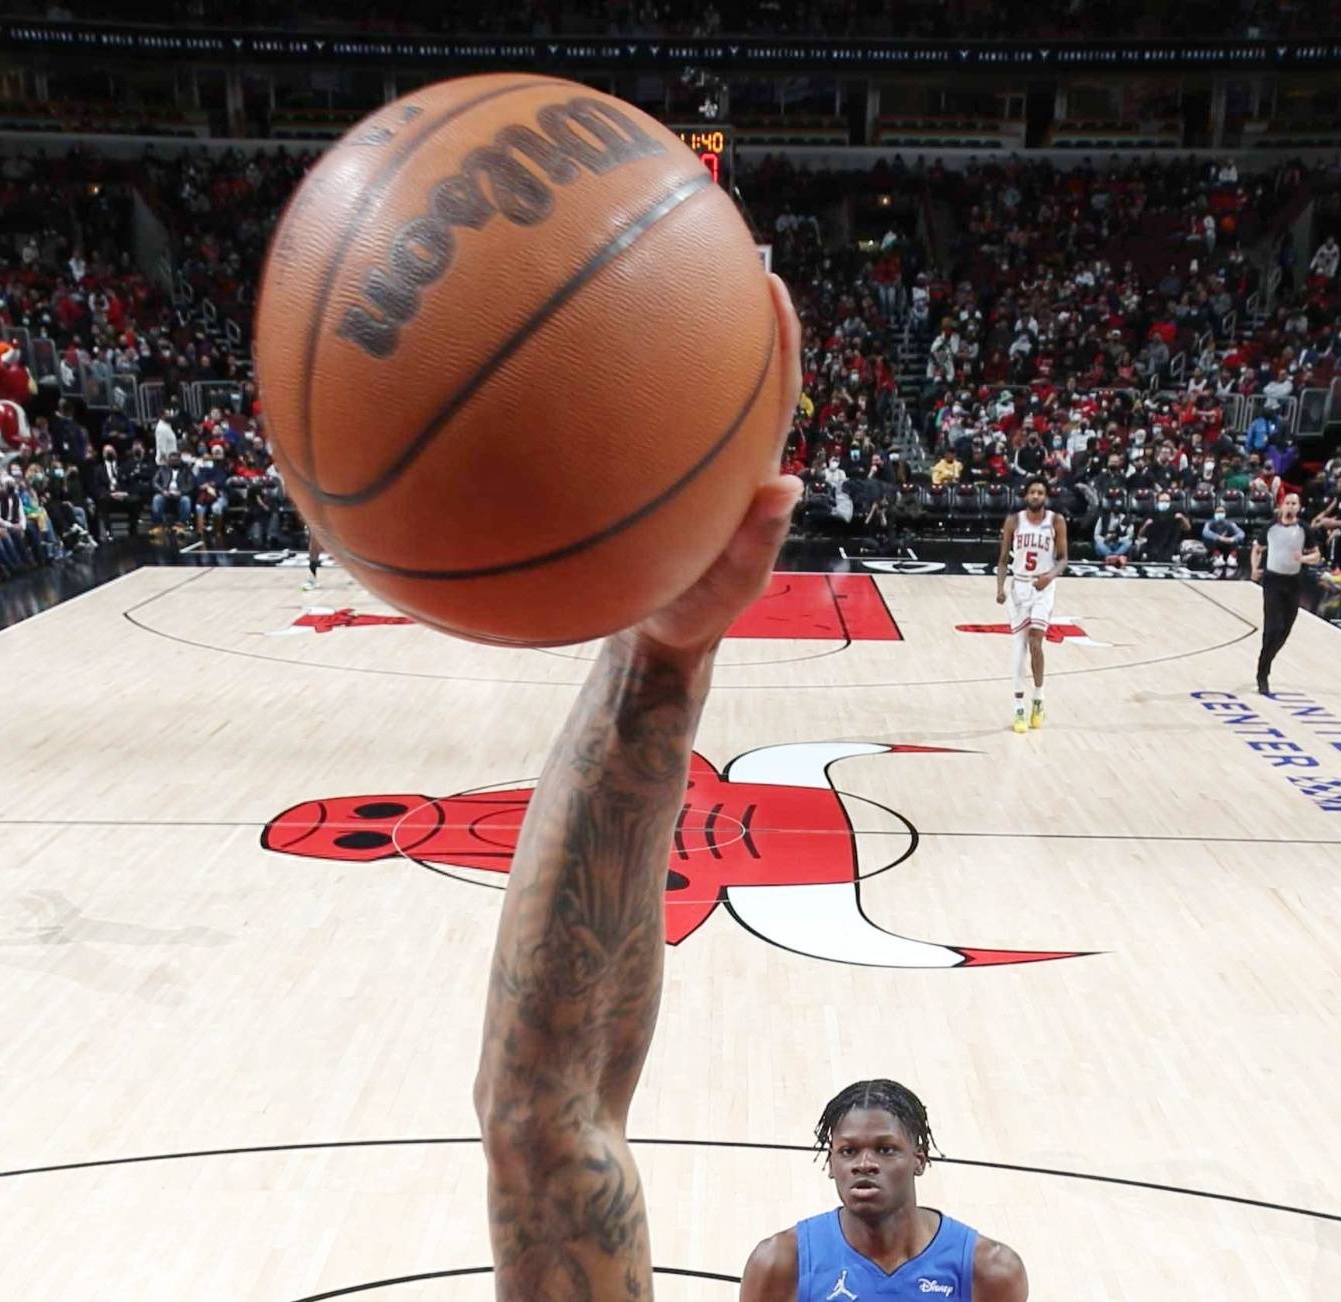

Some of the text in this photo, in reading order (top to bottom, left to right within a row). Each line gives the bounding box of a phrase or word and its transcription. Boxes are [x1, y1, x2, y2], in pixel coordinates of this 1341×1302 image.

[1016, 533, 1051, 552] BULLS
[1025, 551, 1038, 571] 5
[1190, 690, 1321, 768] CENTER
[918, 1277, 955, 1298] Disney
